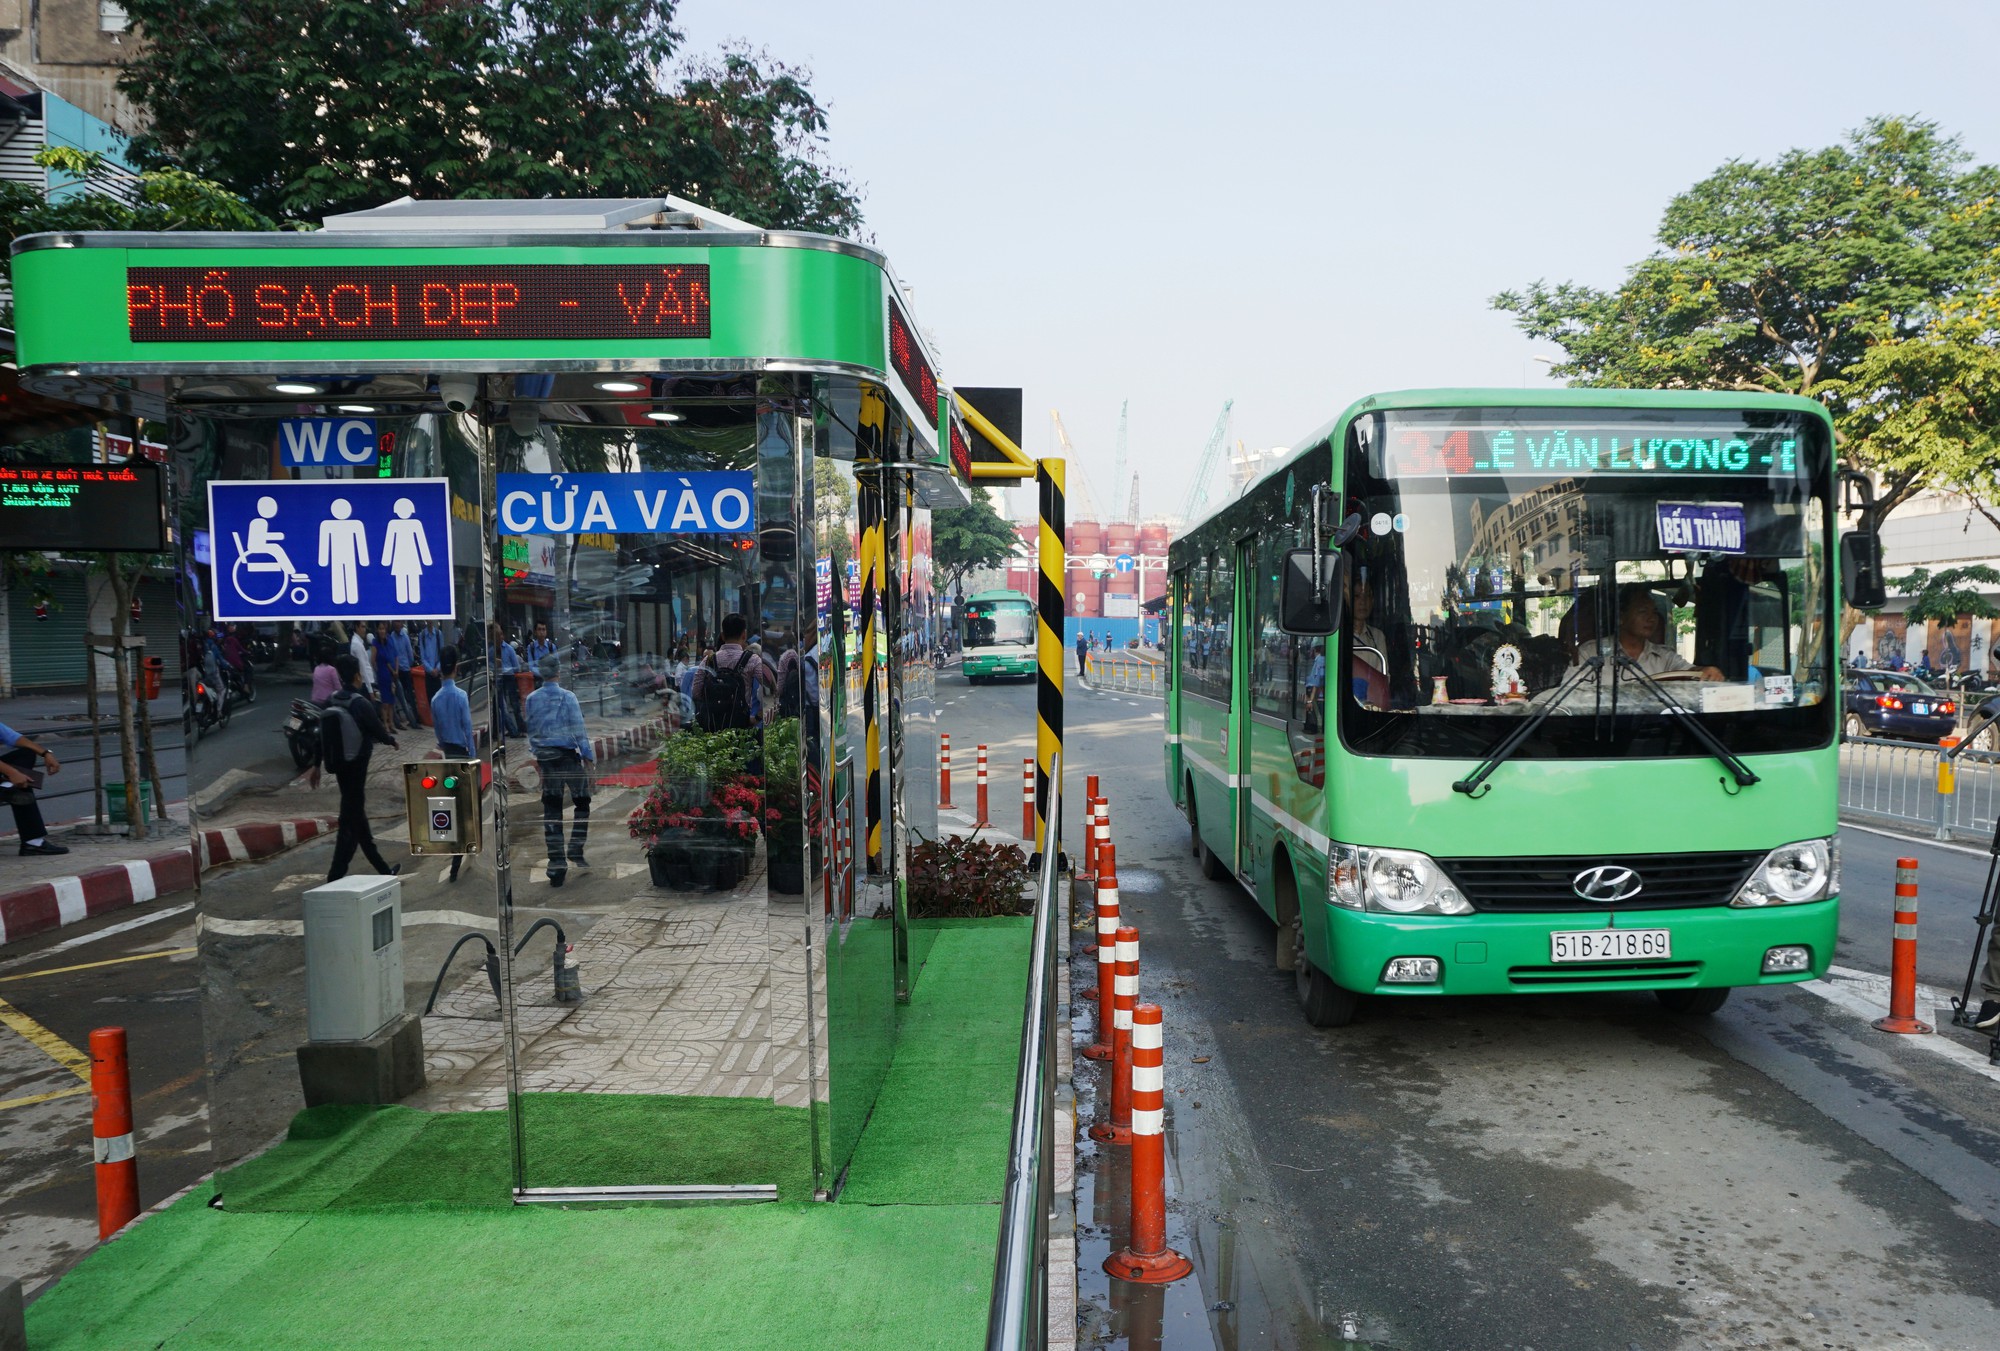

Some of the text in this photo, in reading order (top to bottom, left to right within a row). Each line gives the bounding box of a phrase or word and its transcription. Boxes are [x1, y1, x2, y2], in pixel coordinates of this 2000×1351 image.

[255, 284, 400, 336] SẠCH
[419, 283, 520, 335] ĐẸP
[282, 420, 374, 463] WC
[1398, 430, 1475, 473] 34
[1525, 430, 1599, 468] VĂN
[1610, 438, 1750, 470] LƯƠNG
[502, 475, 617, 532] CỬA
[634, 477, 750, 530] VÀO
[1662, 507, 1741, 549] BẾN THÀNH
[1556, 933, 1665, 957] 51B-218.69
